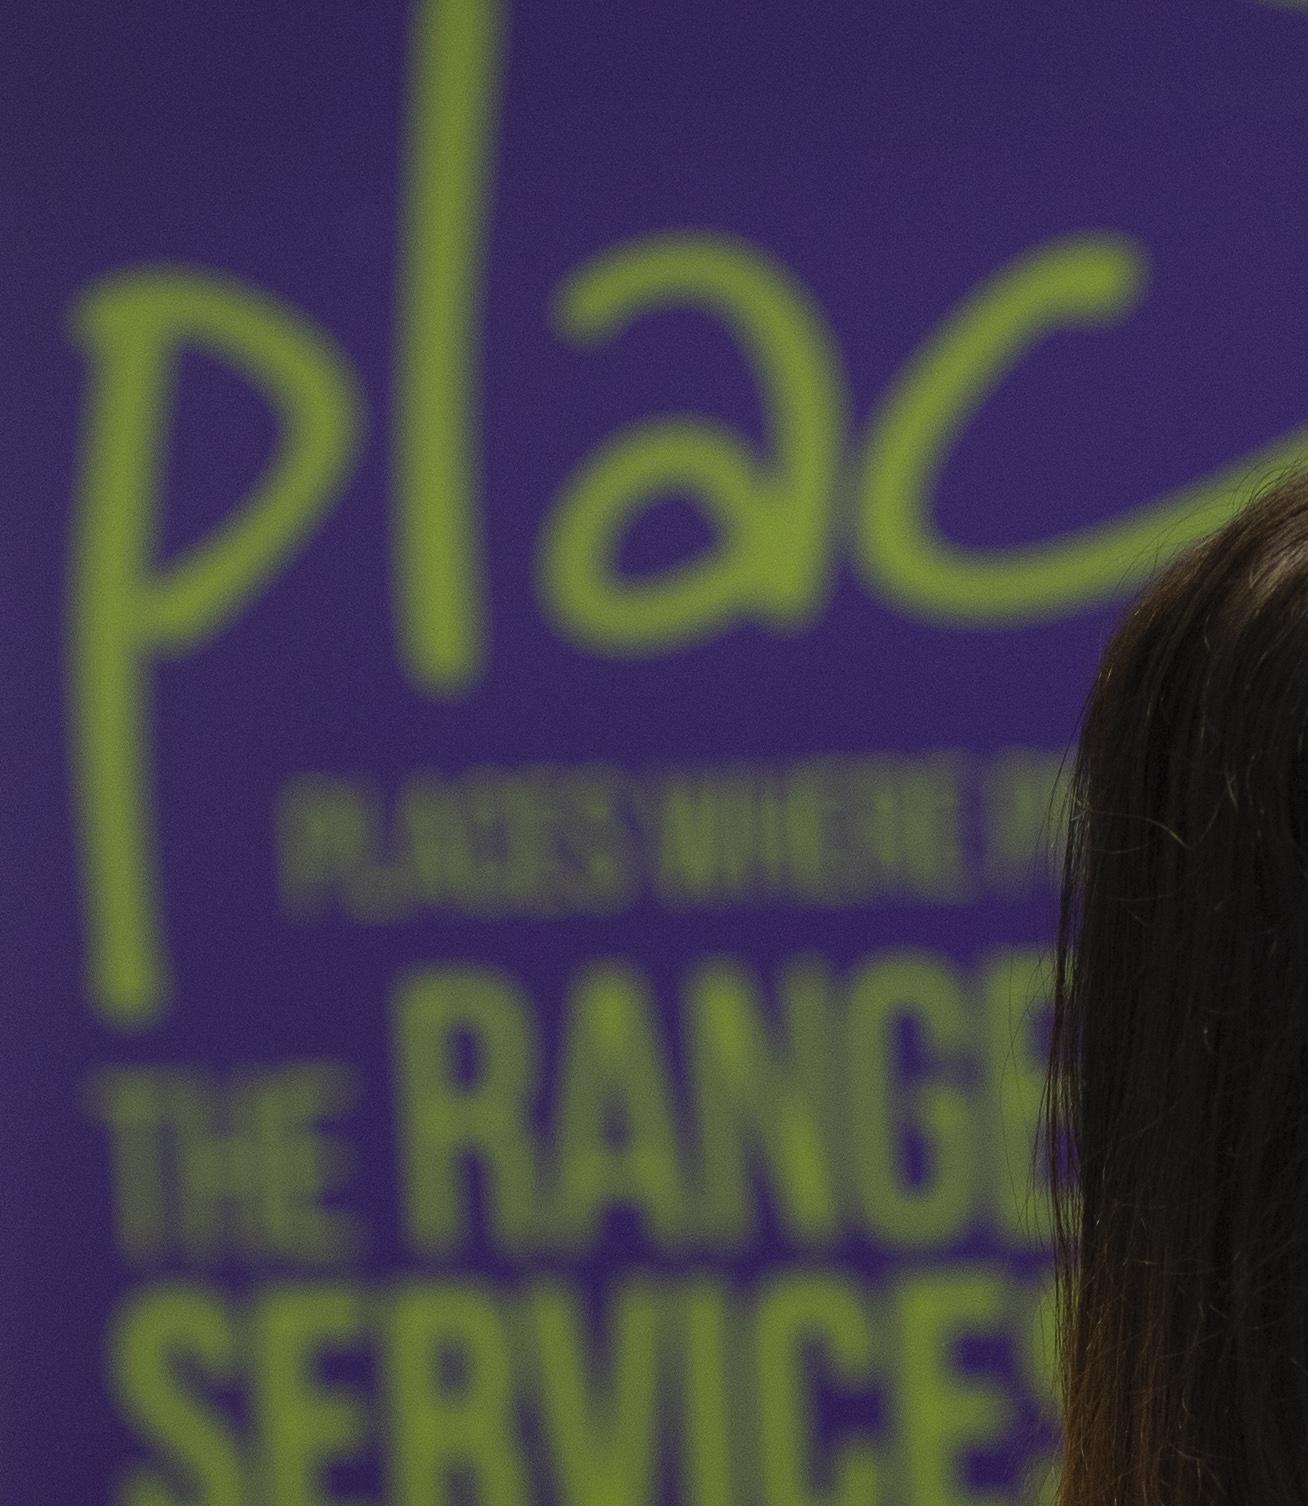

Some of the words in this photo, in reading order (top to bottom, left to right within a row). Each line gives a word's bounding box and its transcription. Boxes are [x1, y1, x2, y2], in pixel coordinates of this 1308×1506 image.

[278, 768, 640, 925] PLACES
[650, 748, 982, 908] WHERE
[85, 1060, 365, 1262] THE
